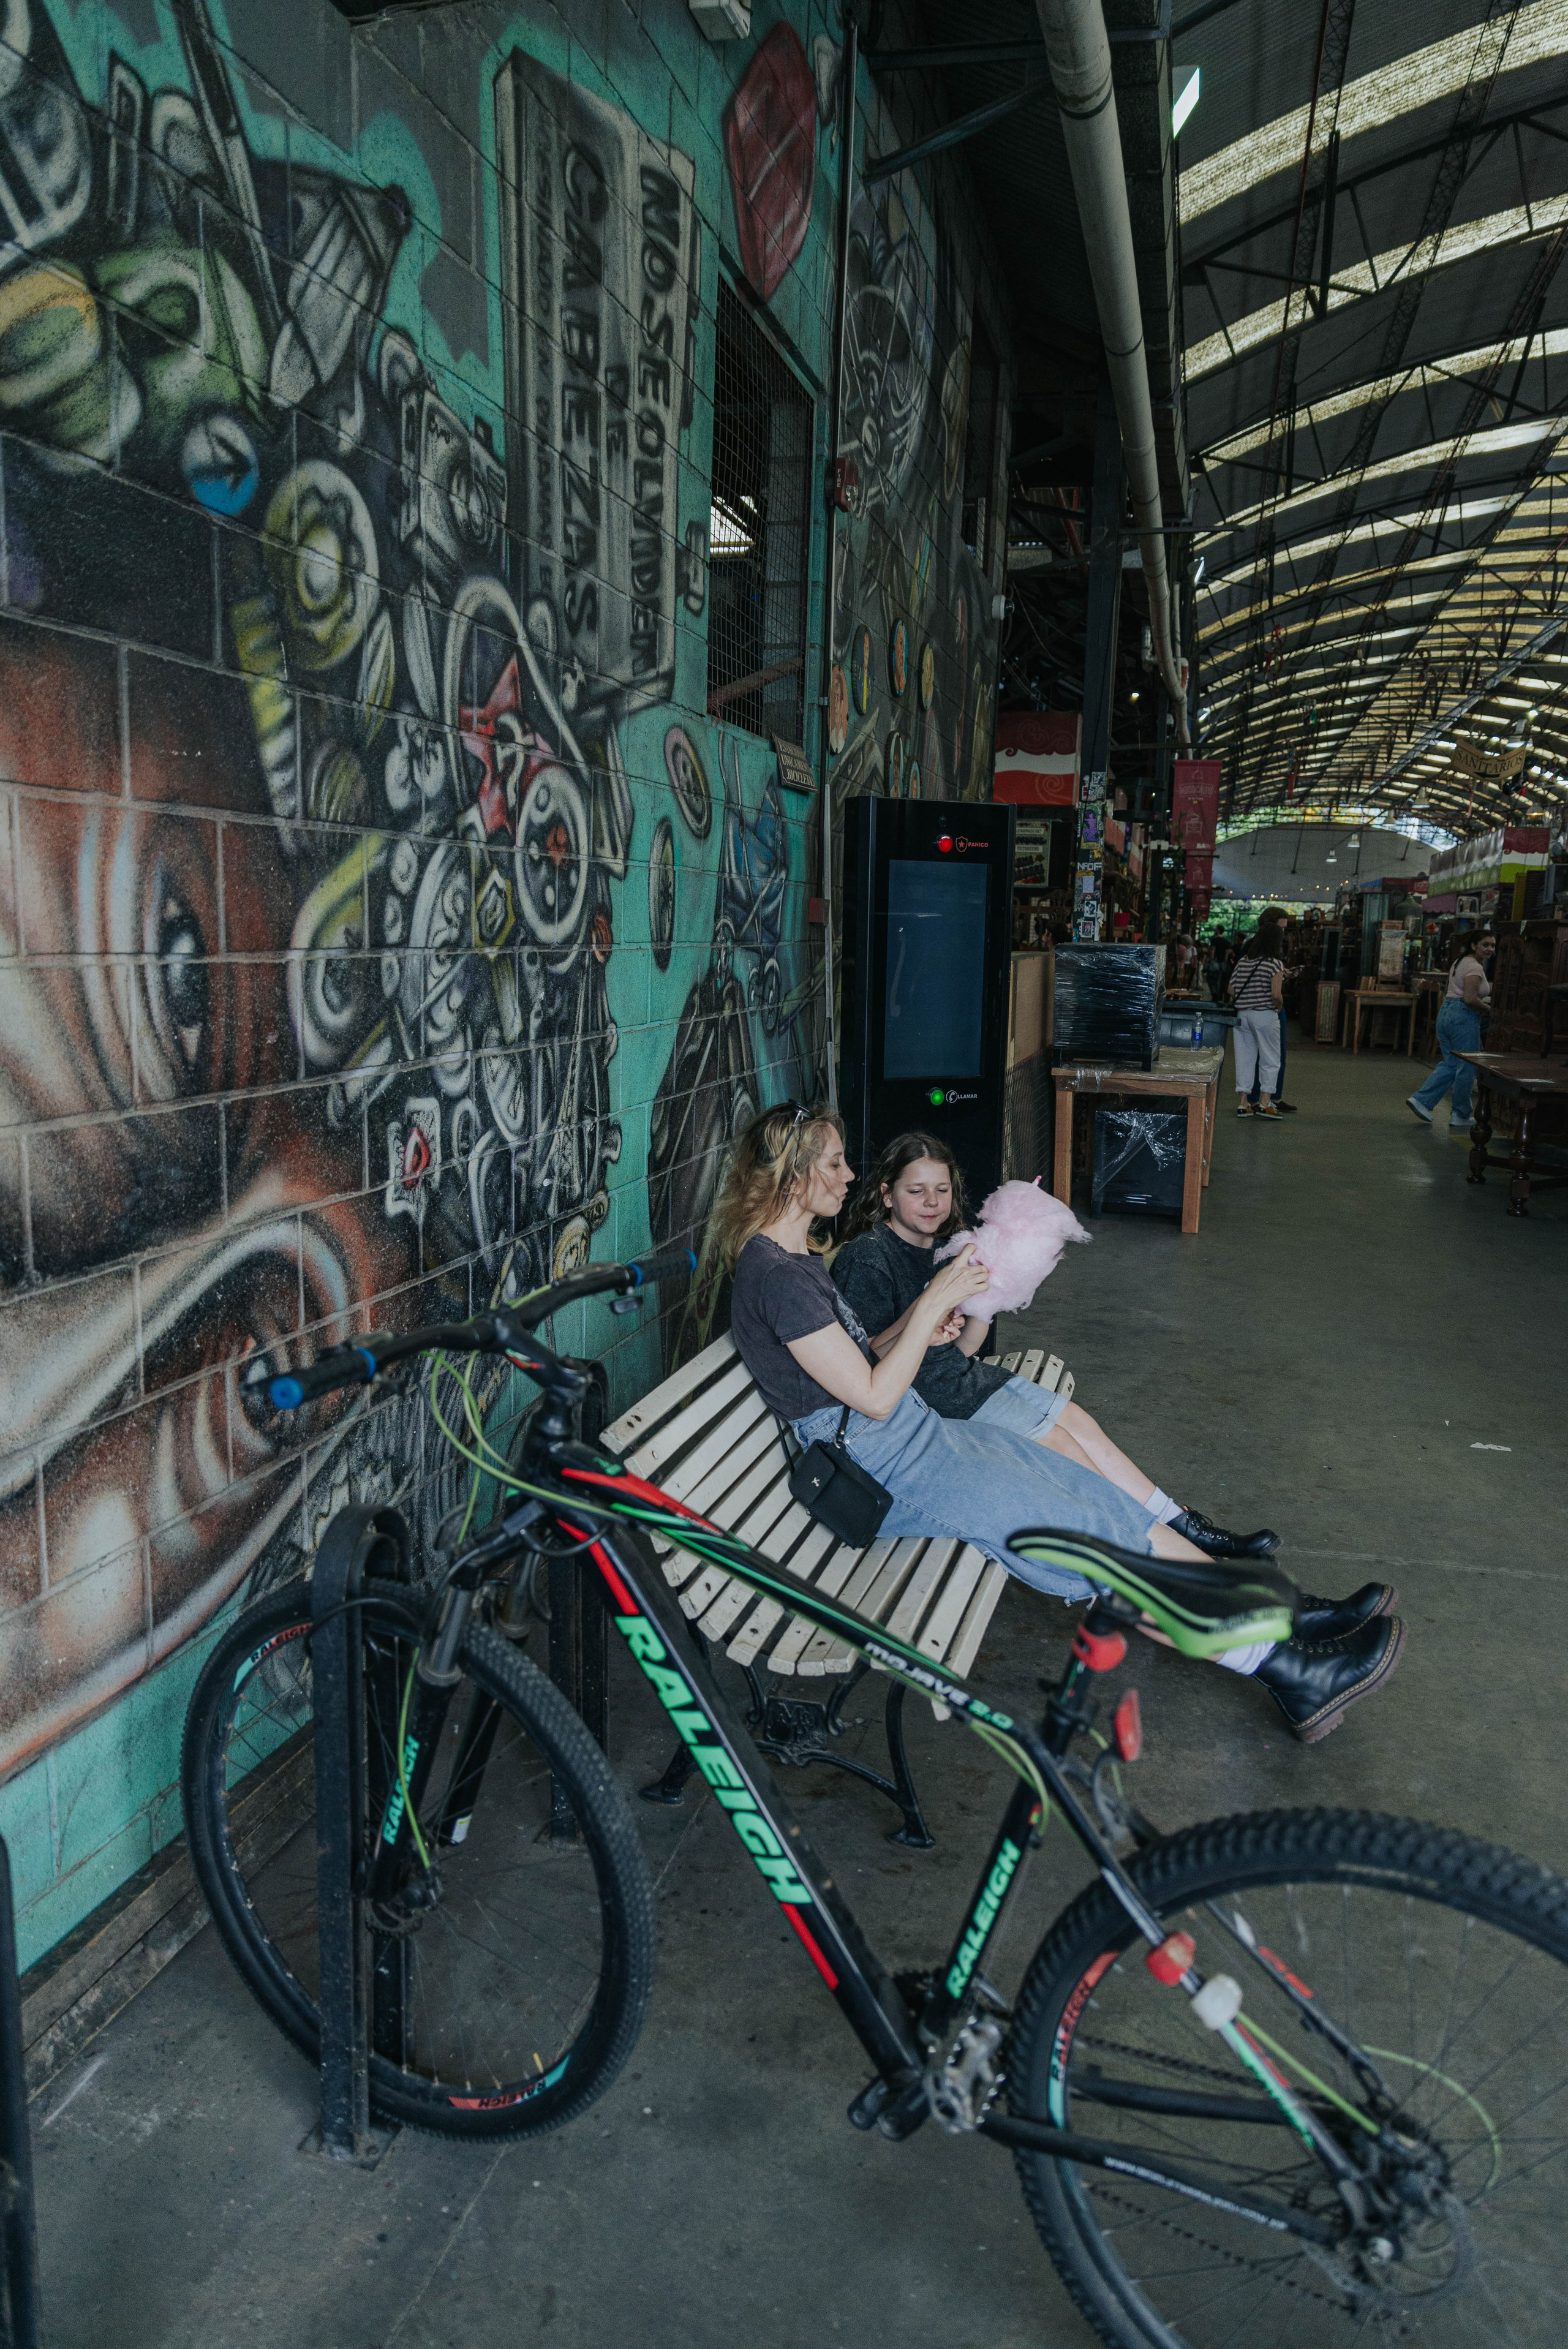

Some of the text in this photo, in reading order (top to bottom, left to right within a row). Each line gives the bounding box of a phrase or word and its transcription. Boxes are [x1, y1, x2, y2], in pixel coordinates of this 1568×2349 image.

[561, 145, 609, 637] CABEZAS
[605, 364, 631, 462] DE
[1457, 752, 1522, 773] SANITARIOS
[614, 1616, 813, 1904] RALEIGH
[968, 1699, 1014, 1730] 2.0
[945, 1836, 1022, 2000] RALEIGH
